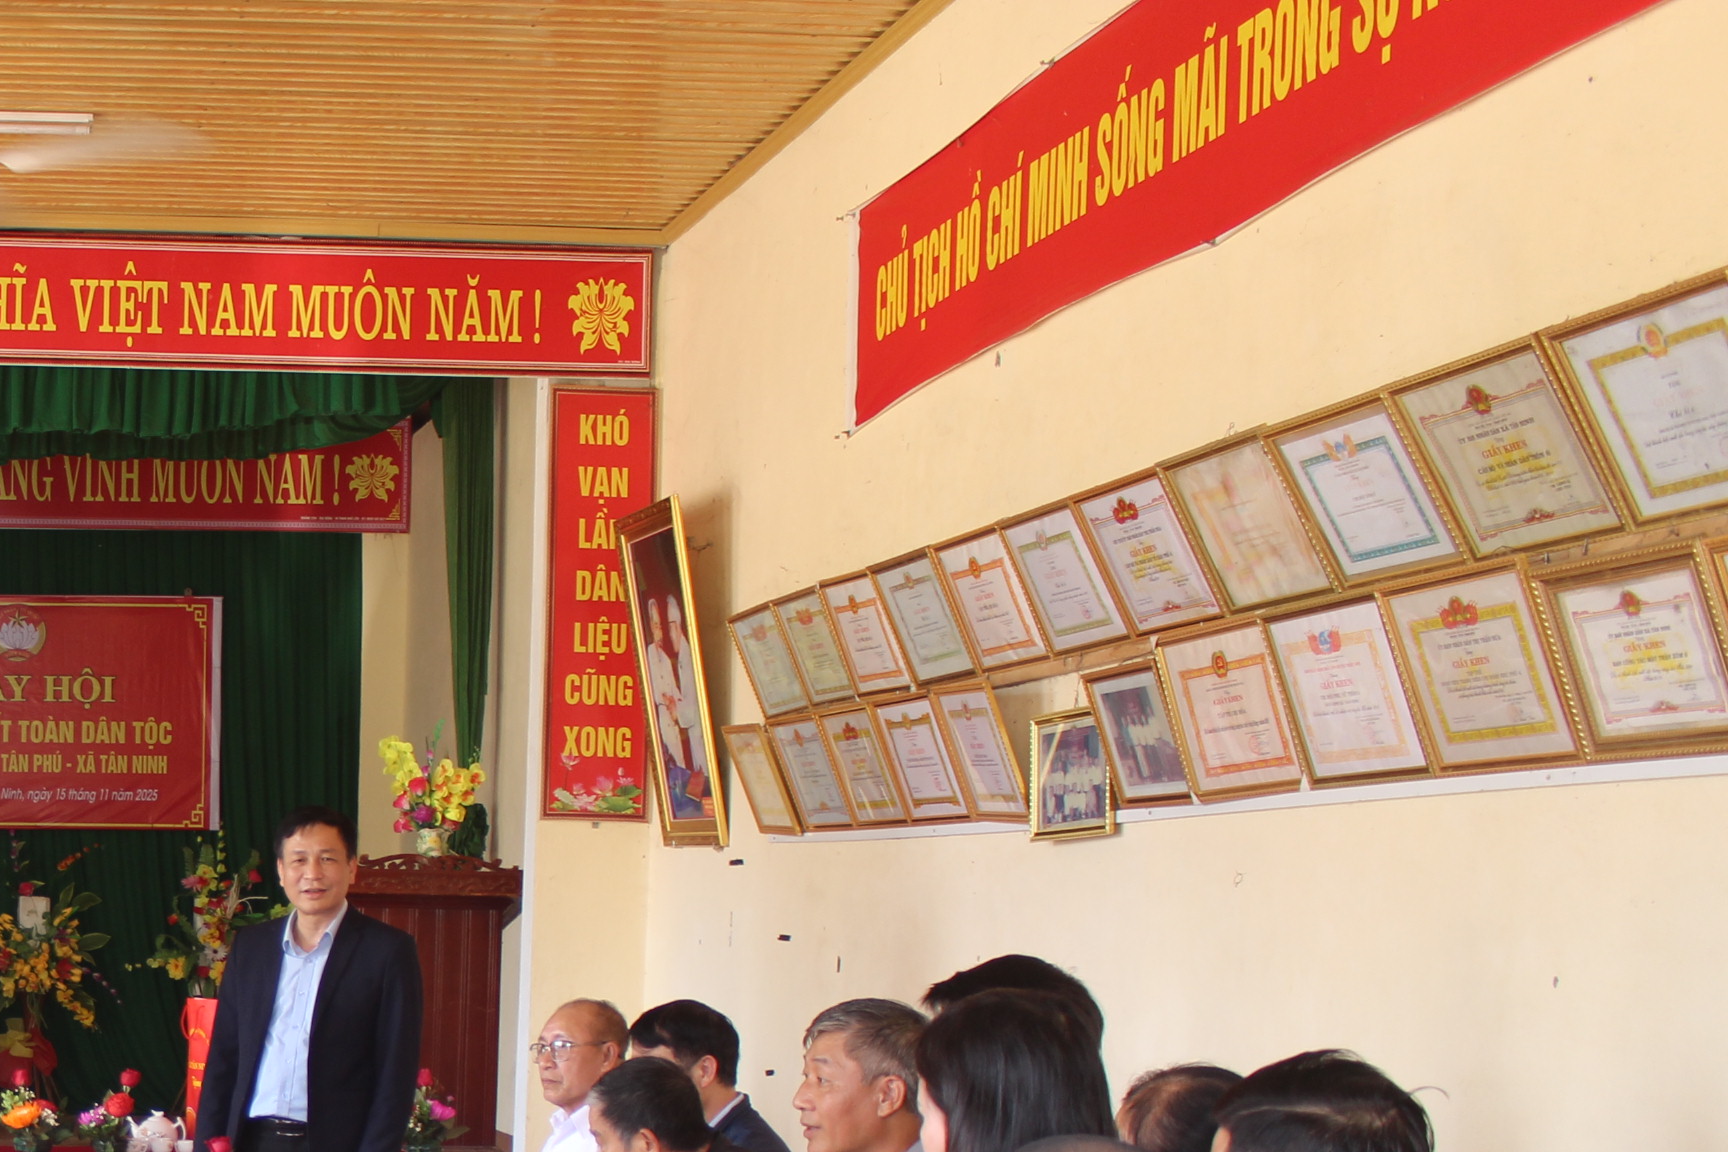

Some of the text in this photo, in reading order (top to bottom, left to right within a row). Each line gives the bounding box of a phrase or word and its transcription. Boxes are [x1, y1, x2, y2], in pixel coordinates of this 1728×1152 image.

[876, 224, 909, 341] CHỦ
[913, 219, 952, 330] TỊCH
[955, 170, 981, 291] HỒ
[986, 151, 1024, 270] CHÍ
[1027, 126, 1090, 247] MINH
[1095, 65, 1165, 206] SỐNG
[1172, 22, 1228, 163] MÃI
[1237, 0, 1341, 123] TRONG
[70, 261, 168, 347] VIỆT
[179, 282, 278, 337] NAM
[288, 269, 415, 340] MUÔN
[579, 409, 629, 446] KHÓ
[63, 453, 141, 503] VINH
[578, 466, 628, 504] VẠN
[576, 564, 626, 602] DÂN
[574, 616, 627, 660] LIỆU
[44, 668, 117, 709] HỘI
[565, 668, 633, 706] CŨNG
[18, 715, 74, 743] TOÀN
[81, 718, 126, 744] DÂN
[132, 717, 173, 750] TỘC
[561, 726, 632, 761] XONG
[1, 750, 29, 773] TÂN
[33, 750, 62, 773] PHÚ
[76, 751, 96, 773] XÃ
[100, 750, 128, 774] TÂN
[132, 755, 168, 774] NINH
[27, 788, 53, 804] ngày
[55, 788, 66, 801] 15
[68, 788, 97, 804] tháng
[135, 788, 159, 802] 2025
